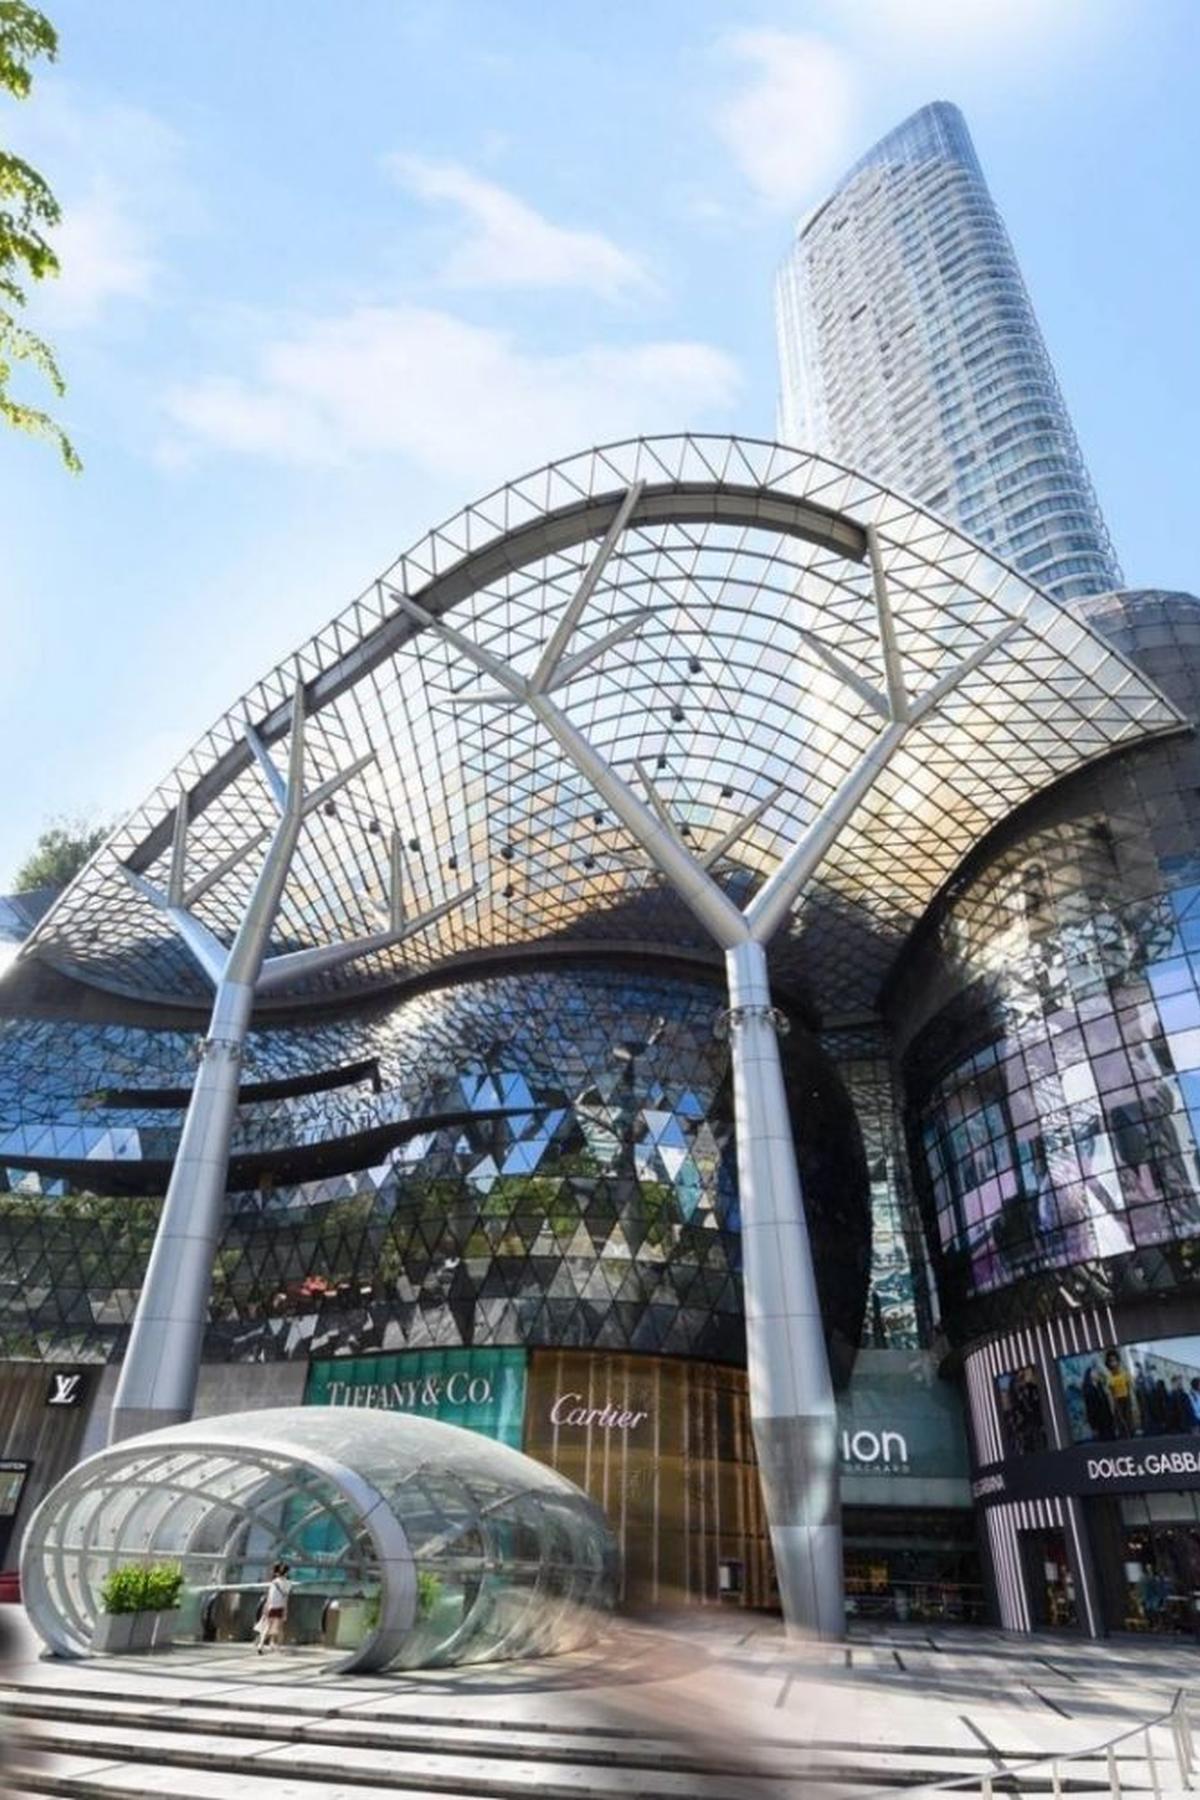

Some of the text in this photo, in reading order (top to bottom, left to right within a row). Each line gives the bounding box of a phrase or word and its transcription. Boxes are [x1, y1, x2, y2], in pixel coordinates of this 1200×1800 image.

[327, 1381, 421, 1408] TIFFANY
[550, 1392, 648, 1429] Cartier
[1087, 1456, 1136, 1480] DOLCE
[1145, 1452, 1200, 1475] GABB
